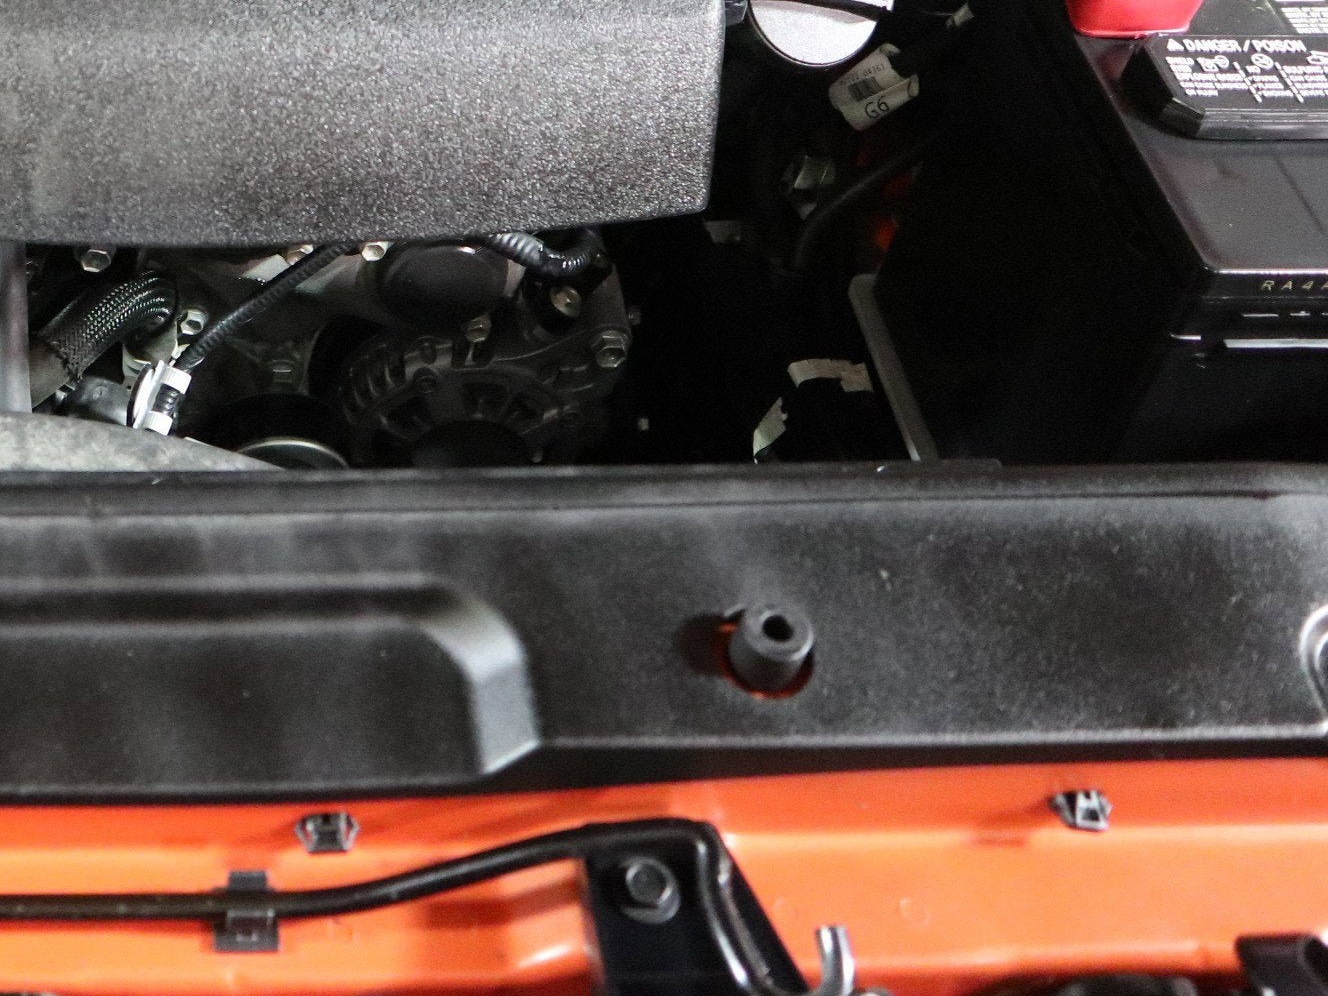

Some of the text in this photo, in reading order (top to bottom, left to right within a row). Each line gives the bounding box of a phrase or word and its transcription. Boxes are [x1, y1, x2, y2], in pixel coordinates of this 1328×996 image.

[1182, 39, 1242, 52] DANGER
[1251, 39, 1307, 52] POISON
[865, 94, 890, 119] G6
